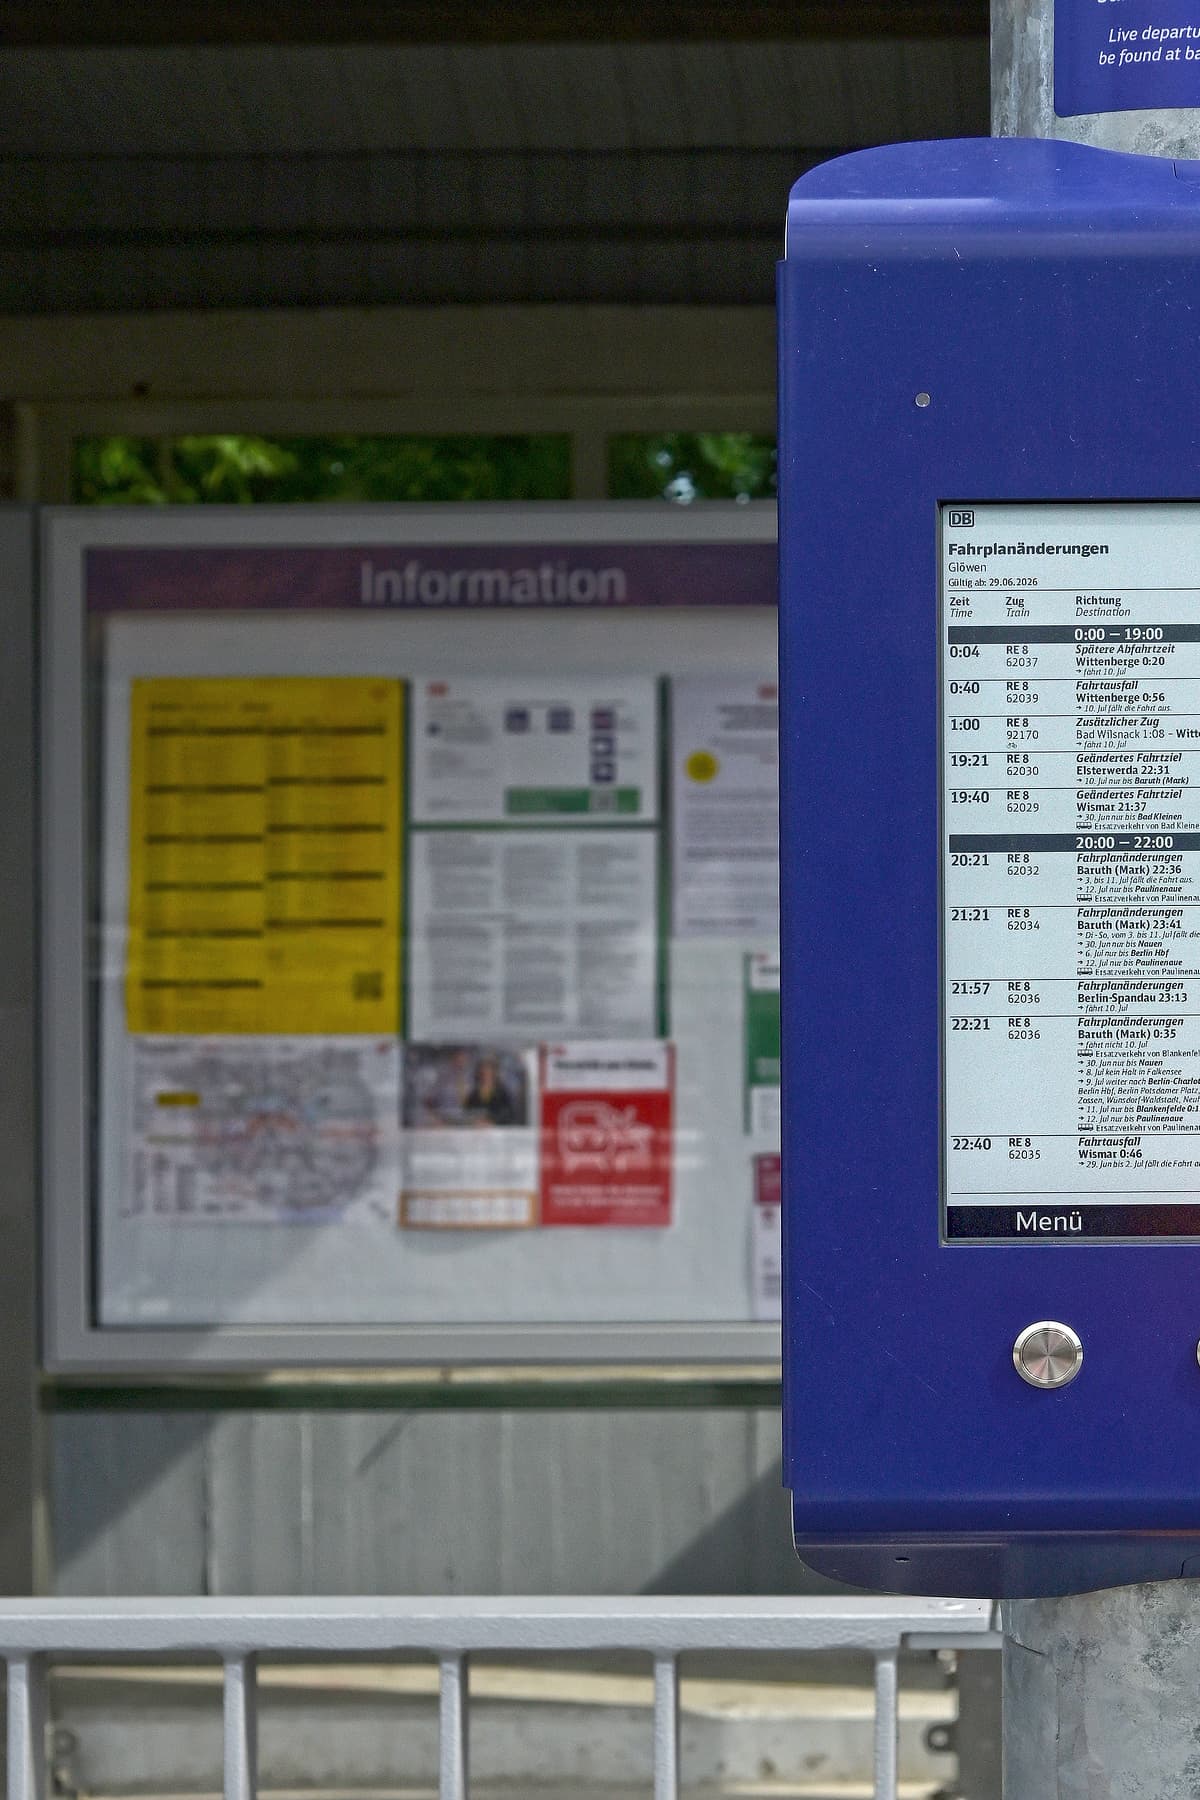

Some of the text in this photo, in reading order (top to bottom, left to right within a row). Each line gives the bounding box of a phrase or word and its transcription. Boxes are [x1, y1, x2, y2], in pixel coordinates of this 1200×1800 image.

[1109, 28, 1137, 43] Live
[1099, 51, 1115, 65] be
[1119, 47, 1160, 67] found
[1165, 48, 1181, 61] at
[950, 512, 973, 526] DB
[949, 542, 1109, 557] Fahrplanänderungen
[949, 562, 987, 573] Glöwen
[361, 560, 626, 602] Information
[949, 578, 1038, 587] Gültig ab: 29.06.2026
[950, 597, 970, 605] Zeit
[1006, 597, 1024, 607] Zug
[1076, 596, 1121, 607] Richtung
[950, 608, 973, 618] Time
[1006, 608, 1030, 617] Train
[1076, 607, 1131, 617] Destination
[1075, 629, 1105, 640] 0:00
[1125, 628, 1163, 640] 19:00
[950, 646, 980, 658] 0:04
[1006, 646, 1028, 654] RE 8
[1076, 644, 1175, 655] Spätere Abfahrtzeit
[1006, 657, 1038, 667] 62037
[1076, 656, 1165, 668] Wittenberge 0:20
[950, 682, 980, 694] 0:40
[1006, 682, 1029, 691] RE 8
[1076, 681, 1138, 691] Fahrtausfall
[1006, 694, 1039, 703] 62039
[1076, 692, 1165, 704] Wittenberge 0:56
[951, 719, 980, 730] 1:00
[1007, 718, 1029, 727] RE 8
[1076, 717, 1160, 728] Zusätzlicher Zug
[1007, 730, 1039, 740] 92170
[1076, 729, 1094, 739] Bad
[1097, 729, 1139, 738] Wilsnack
[1143, 729, 1165, 738] 1:08
[951, 755, 989, 767] 19:21
[1007, 755, 1029, 763] RE 8
[1076, 753, 1182, 763] Geändertes Fahrtziel
[1007, 767, 1039, 776] 62030
[1077, 765, 1170, 775] Elsterwerda 22:31
[1085, 777, 1097, 785] 10.
[1098, 777, 1108, 786] Jul
[1122, 777, 1133, 785] bis
[1135, 777, 1161, 785] Baruth
[1163, 776, 1189, 785] (Mark)
[951, 791, 990, 803] 19:40
[1007, 791, 1029, 800] RE 8
[1076, 790, 1182, 800] Geändertes Fahrtziel
[1007, 803, 1039, 813] 62029
[1077, 802, 1146, 811] Wismar 21:37
[1124, 813, 1136, 821] bis
[1075, 837, 1115, 849] 20:00
[1134, 837, 1173, 848] 22:00
[951, 854, 989, 866] 20:21
[1007, 854, 1030, 863] RE 8
[1077, 853, 1183, 864] Fahrplanänderungen
[1007, 866, 1039, 875] 62032
[1077, 865, 1182, 876] Baruth (Mark) 22:36
[1135, 885, 1183, 893] Paulinenaue
[952, 909, 990, 921] 21:21
[1007, 909, 1030, 917] RE 8
[1077, 908, 1183, 919] Fahrplanänderungen
[1007, 920, 1040, 930] 62034
[1078, 920, 1182, 931] Baruth (Mark) 23:41
[952, 982, 990, 994] 21:57
[1008, 982, 1030, 991] RE 8
[1078, 981, 1183, 992] Fahrplanänderungen
[1008, 994, 1040, 1003] 62036
[1078, 993, 1187, 1004] Berlin-Spandau 23:13
[952, 1019, 990, 1030] 22:21
[1008, 1018, 1031, 1027] RE 8
[1078, 1017, 1184, 1028] Fahrplanänderungen
[1008, 1030, 1041, 1039] 62036
[1078, 1029, 1176, 1040] Baruth (Mark) 0:35
[1125, 1104, 1134, 1113] bis
[1136, 1104, 1185, 1114] Blankenfelde
[953, 1138, 991, 1150] 22:40
[1008, 1138, 1031, 1147] RE 8
[1078, 1137, 1141, 1147] Fahrtausfall
[1008, 1150, 1041, 1159] 62035
[1079, 1149, 1142, 1159] Wismar 0:46
[1017, 1211, 1082, 1231] Menü
